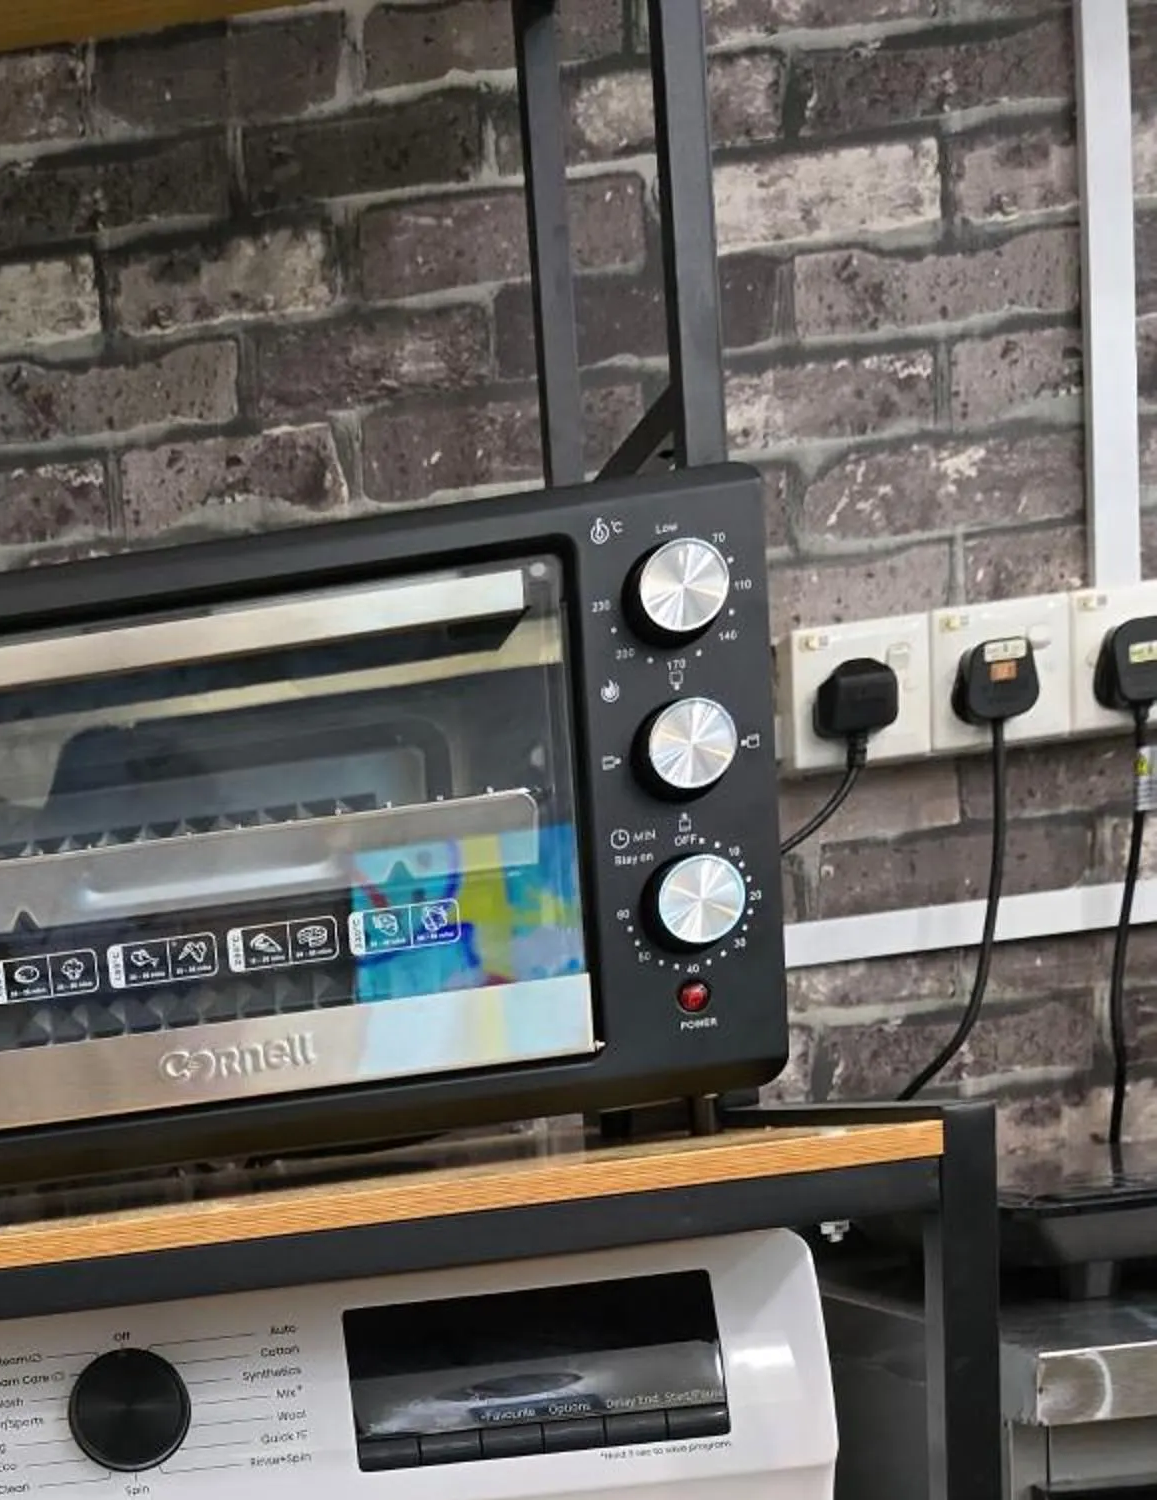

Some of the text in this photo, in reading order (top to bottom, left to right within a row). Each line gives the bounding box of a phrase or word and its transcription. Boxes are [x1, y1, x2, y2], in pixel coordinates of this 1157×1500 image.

[674, 833, 697, 847] OFF
[749, 890, 762, 901] 20
[686, 963, 700, 974] 40
[114, 1331, 130, 1341] Off
